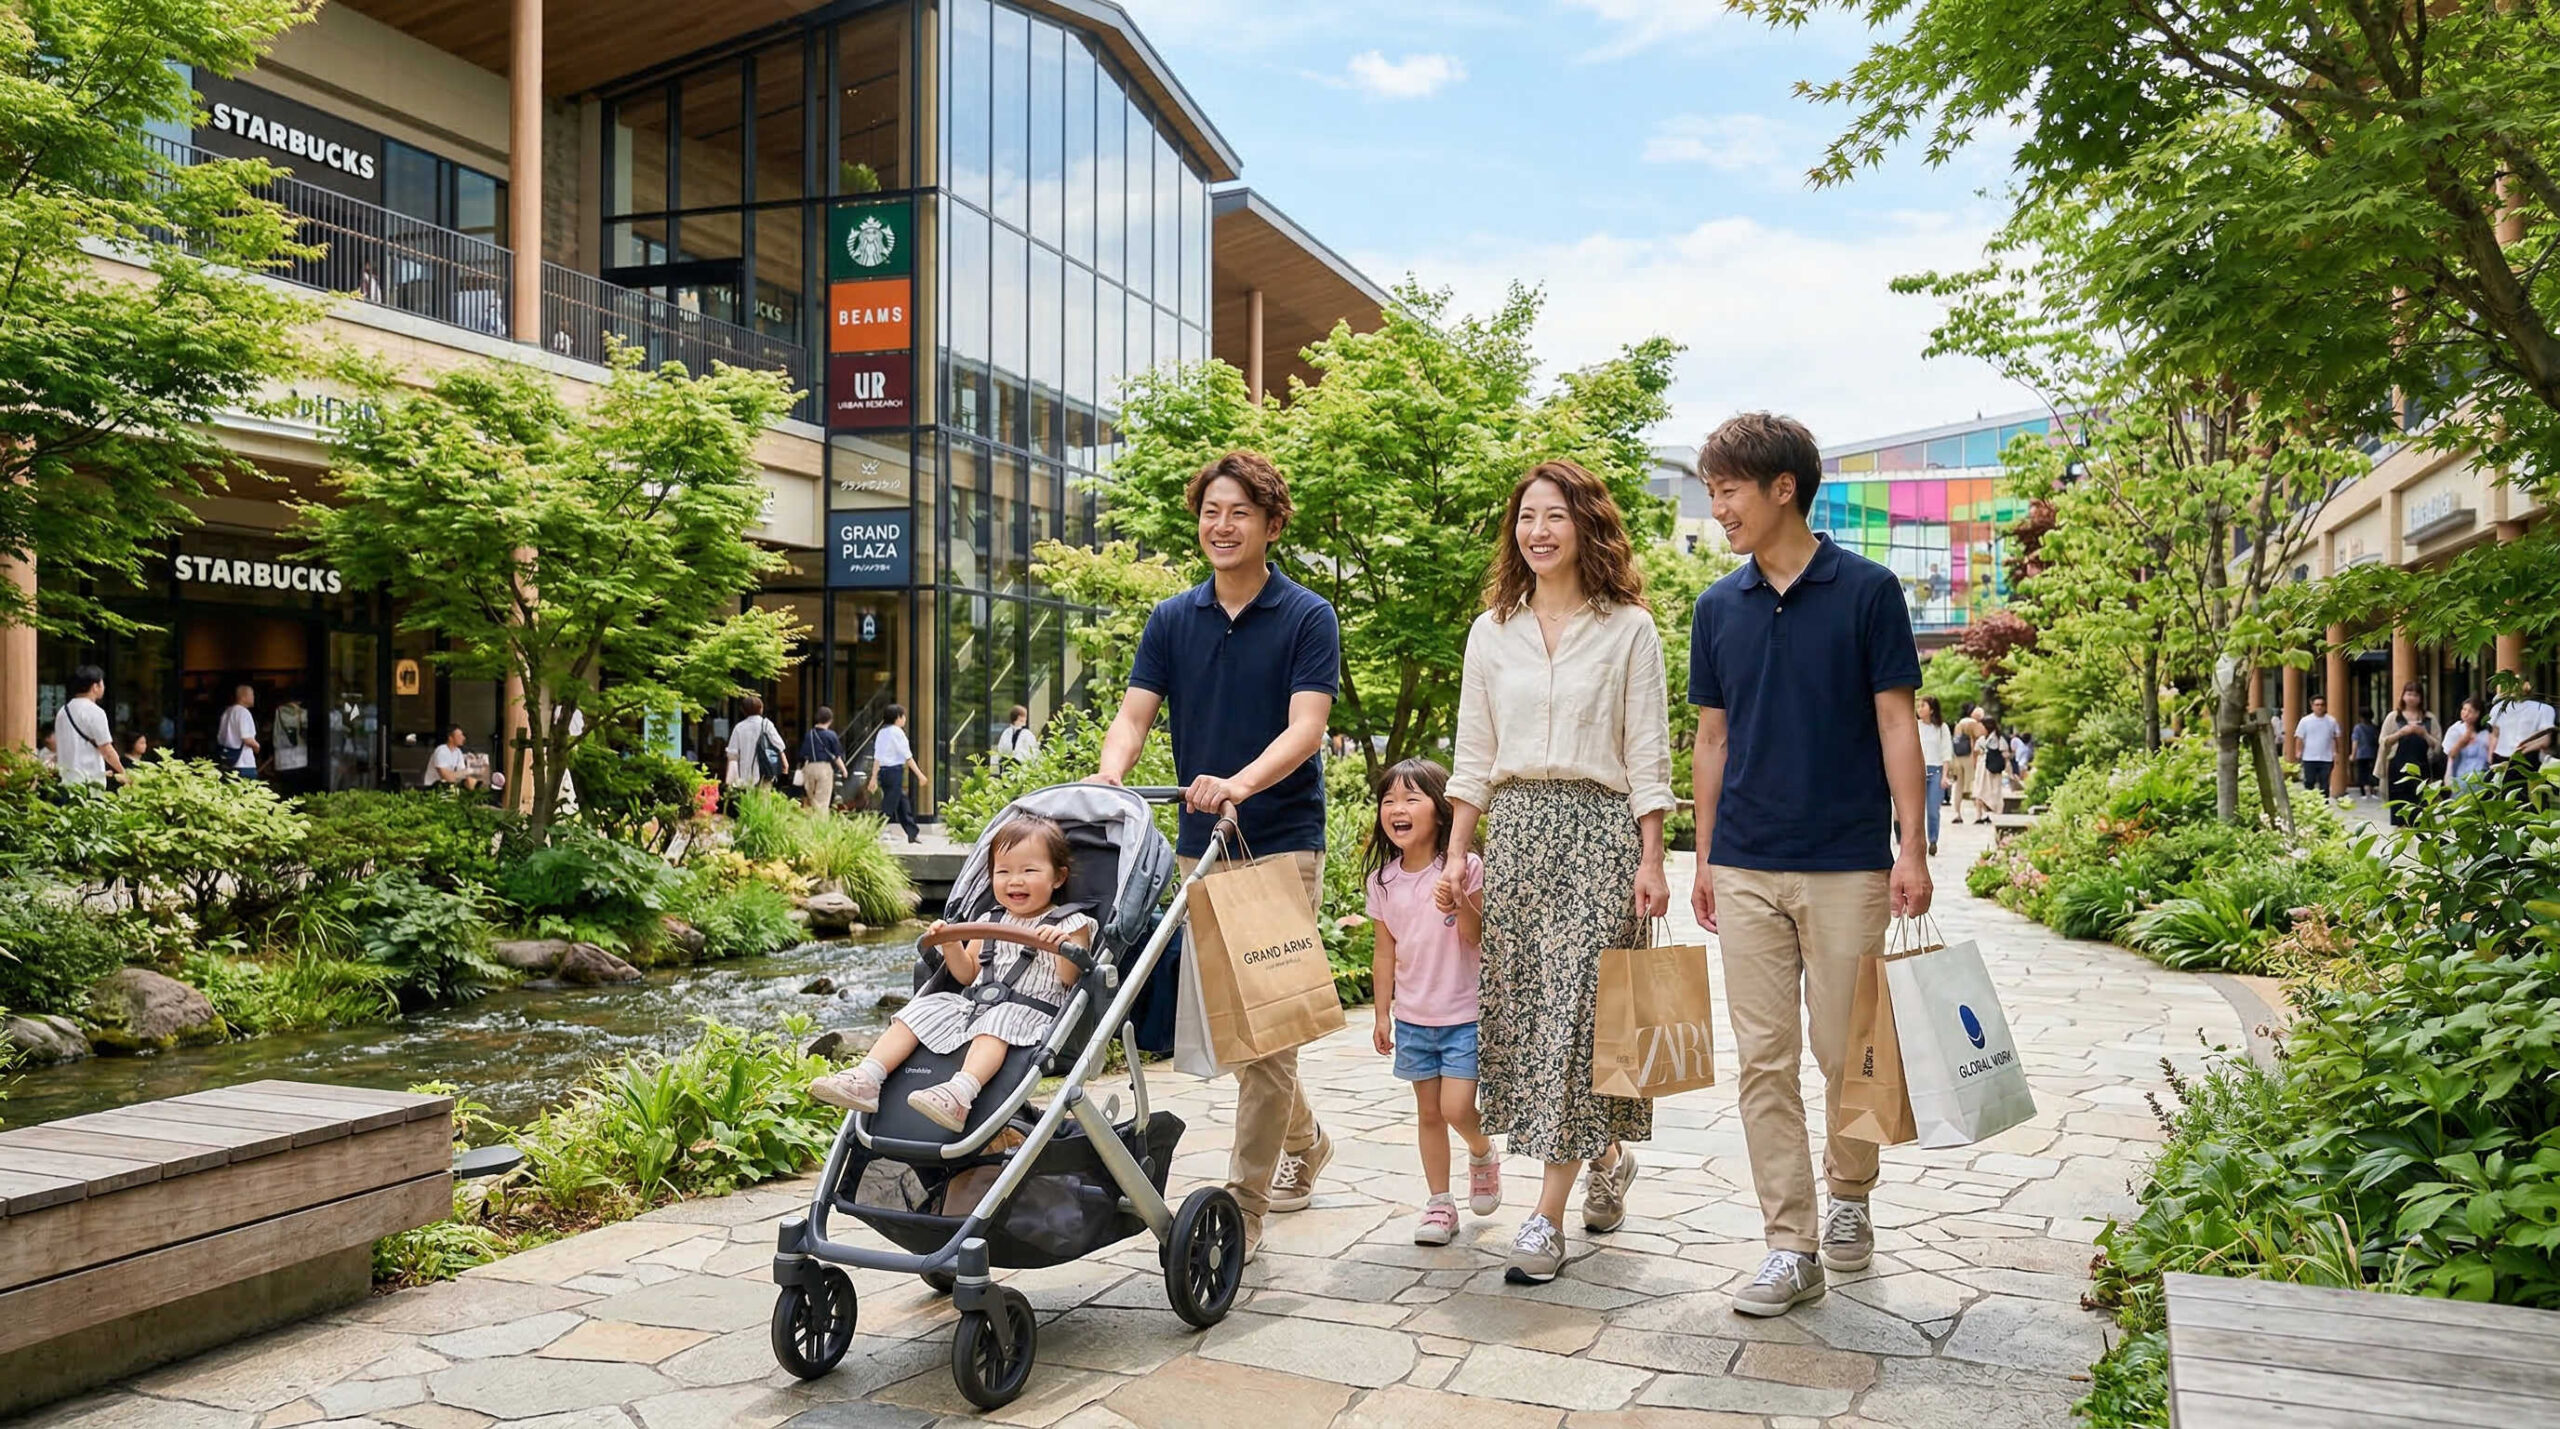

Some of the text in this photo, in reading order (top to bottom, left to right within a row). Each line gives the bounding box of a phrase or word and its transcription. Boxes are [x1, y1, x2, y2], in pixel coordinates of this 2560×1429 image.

[213, 103, 375, 180] STARBUCKS
[839, 306, 903, 326] BEAMS
[854, 371, 886, 400] UR
[837, 400, 903, 410] URBAN RESEARCH
[841, 524, 900, 541] GRAND
[842, 542, 898, 559] PLAZA
[175, 555, 342, 594] STARBUCKS
[1243, 945, 1281, 965] GRAND
[1283, 937, 1313, 955] ARMS
[1959, 1050, 2014, 1079] GLOBAL WORK
